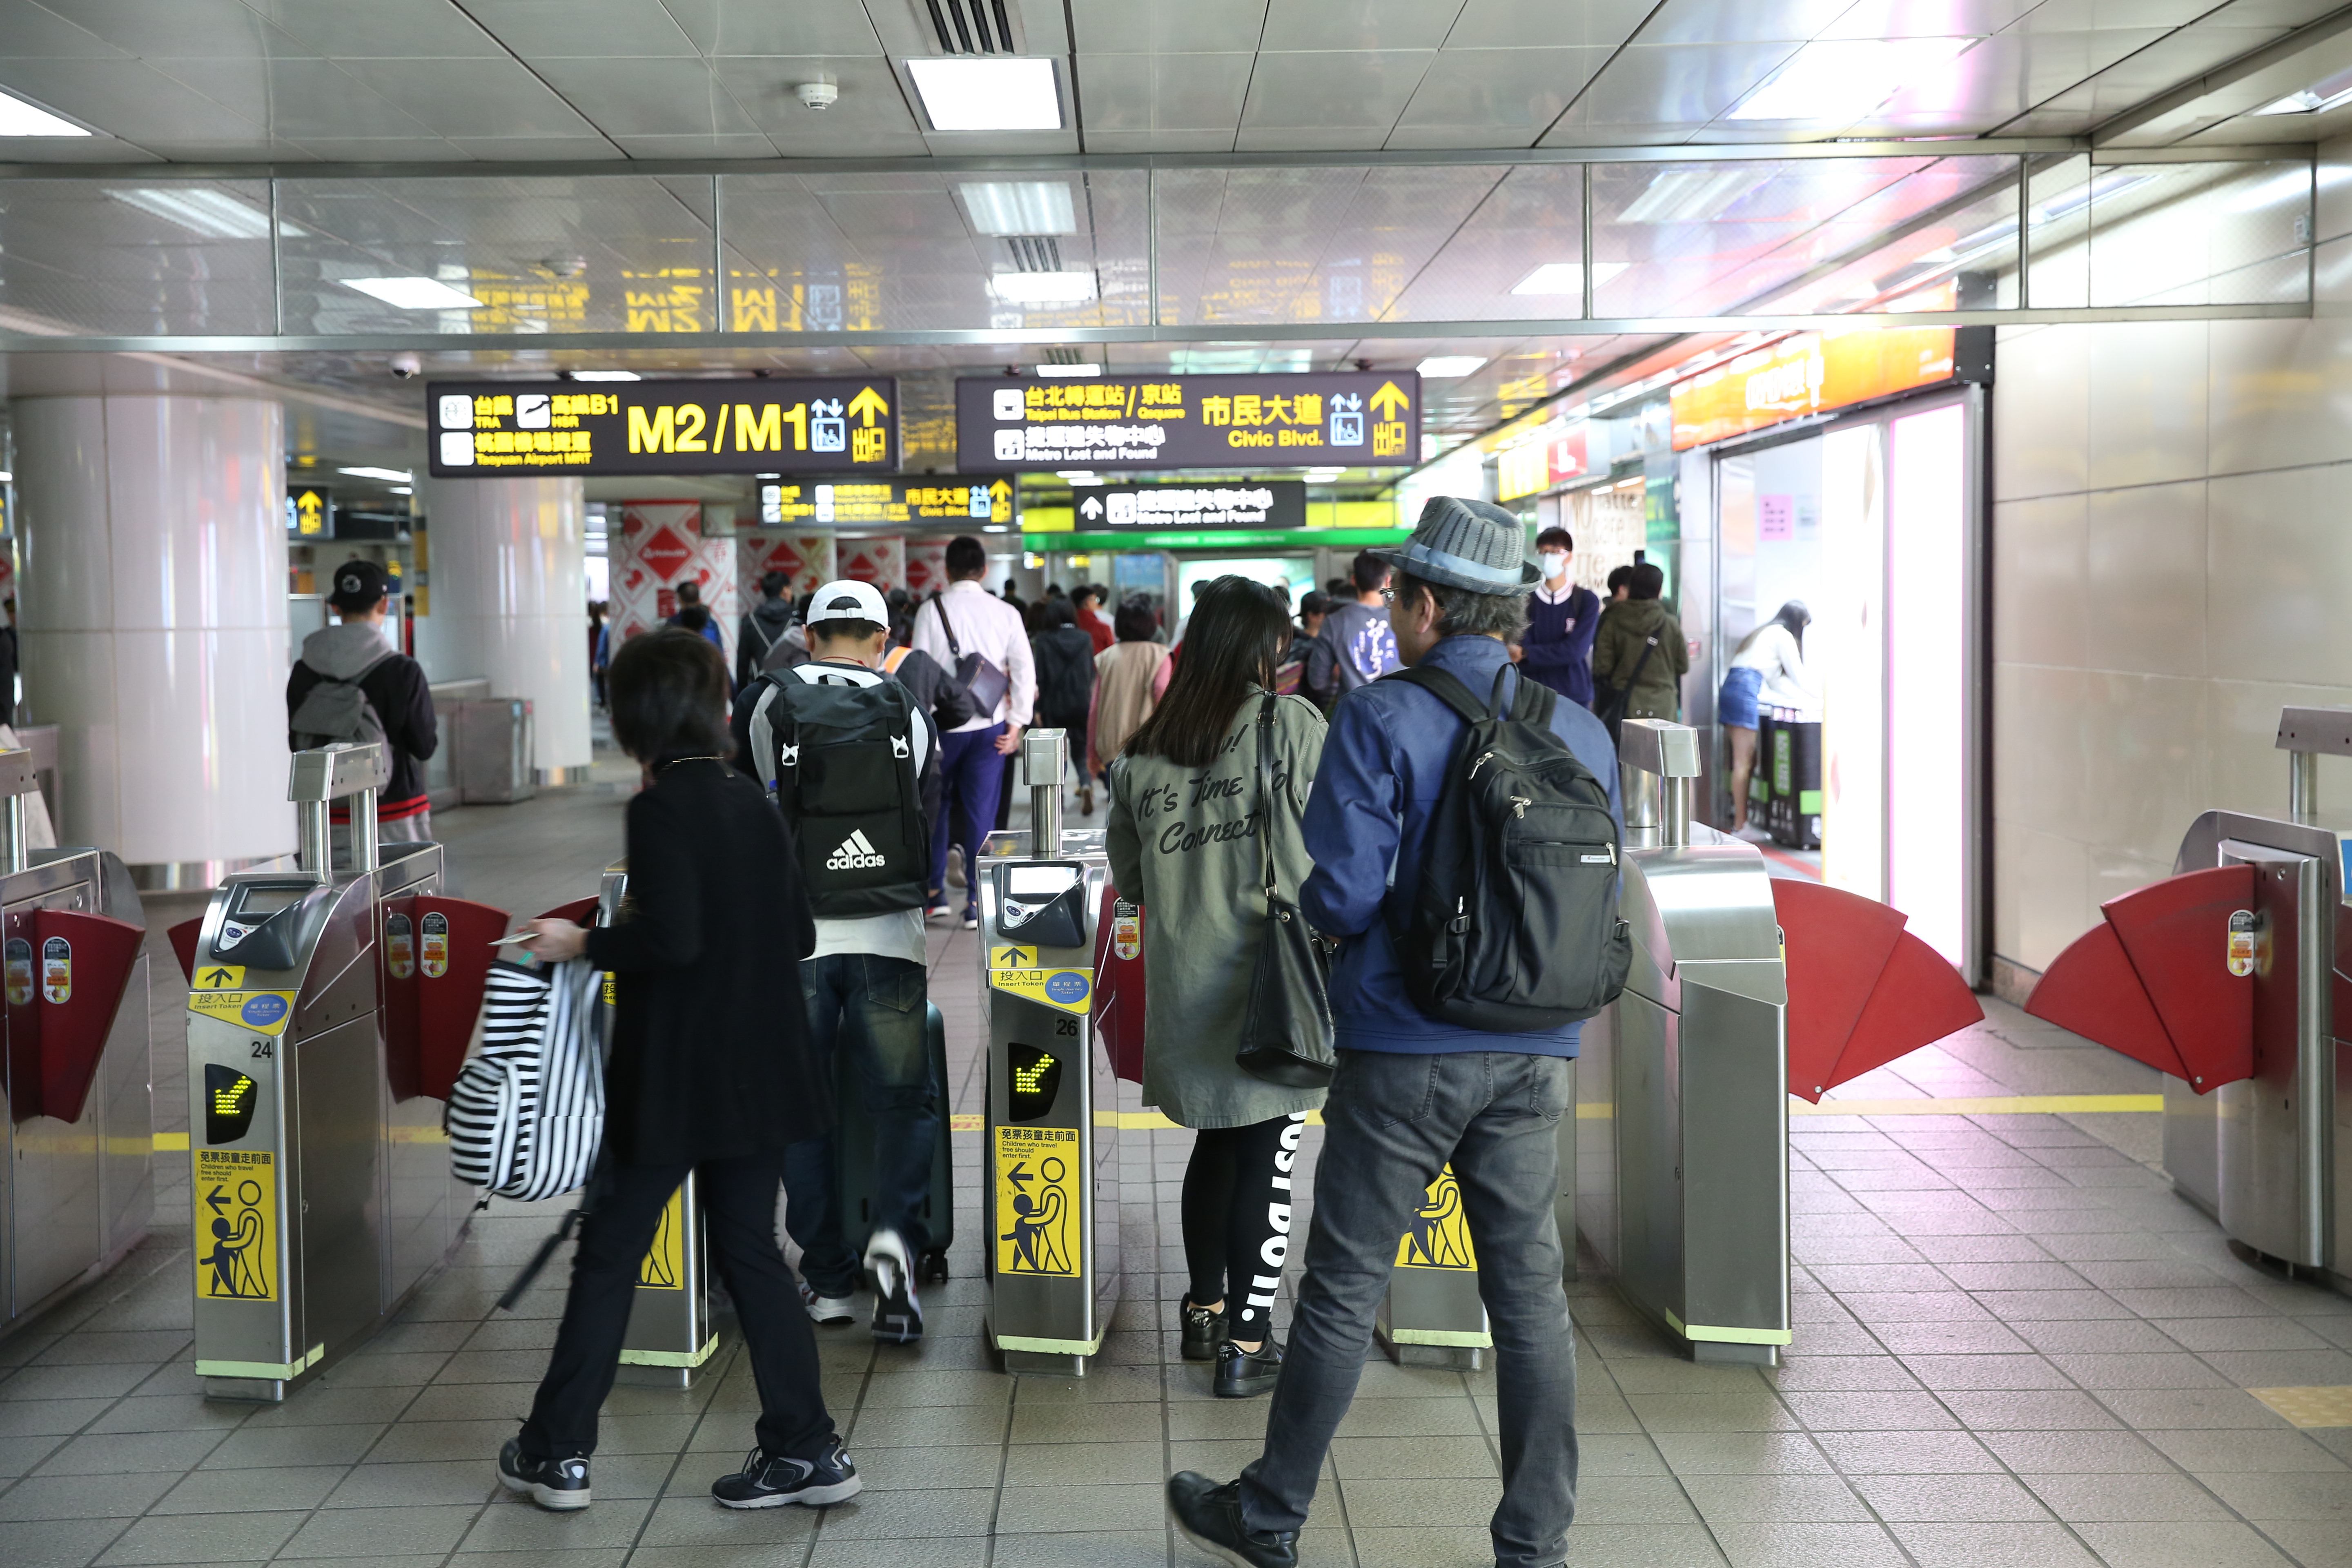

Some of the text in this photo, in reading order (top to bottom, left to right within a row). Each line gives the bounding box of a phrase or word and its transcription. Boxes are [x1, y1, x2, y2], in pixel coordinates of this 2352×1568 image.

[1141, 383, 1182, 405] 京站
[1025, 408, 1057, 422] Taipei
[1081, 407, 1122, 420] Station
[1201, 393, 1323, 427] 市民大道
[473, 416, 501, 428] TRA
[852, 427, 886, 463] 出口
[1228, 429, 1323, 448] Civic Blvd.
[1373, 421, 1406, 457] 出口
[524, 453, 564, 466] Airport
[564, 452, 592, 465] MRT
[1025, 447, 1157, 461] Metro Lost and Found
[905, 487, 970, 506] 市民大道
[1138, 784, 1177, 822] It's
[1189, 770, 1243, 808] Time
[1159, 809, 1262, 855] Connect
[826, 853, 886, 870] adidas
[1000, 971, 1042, 981] 投入口
[198, 993, 243, 1003] 投入口
[1056, 1018, 1078, 1036] 26
[252, 1041, 272, 1058] 24
[1002, 1129, 1076, 1142] 免票孩童走前面
[200, 1151, 271, 1165] 免票孩童走前面
[1260, 1202, 1291, 1268] DO
